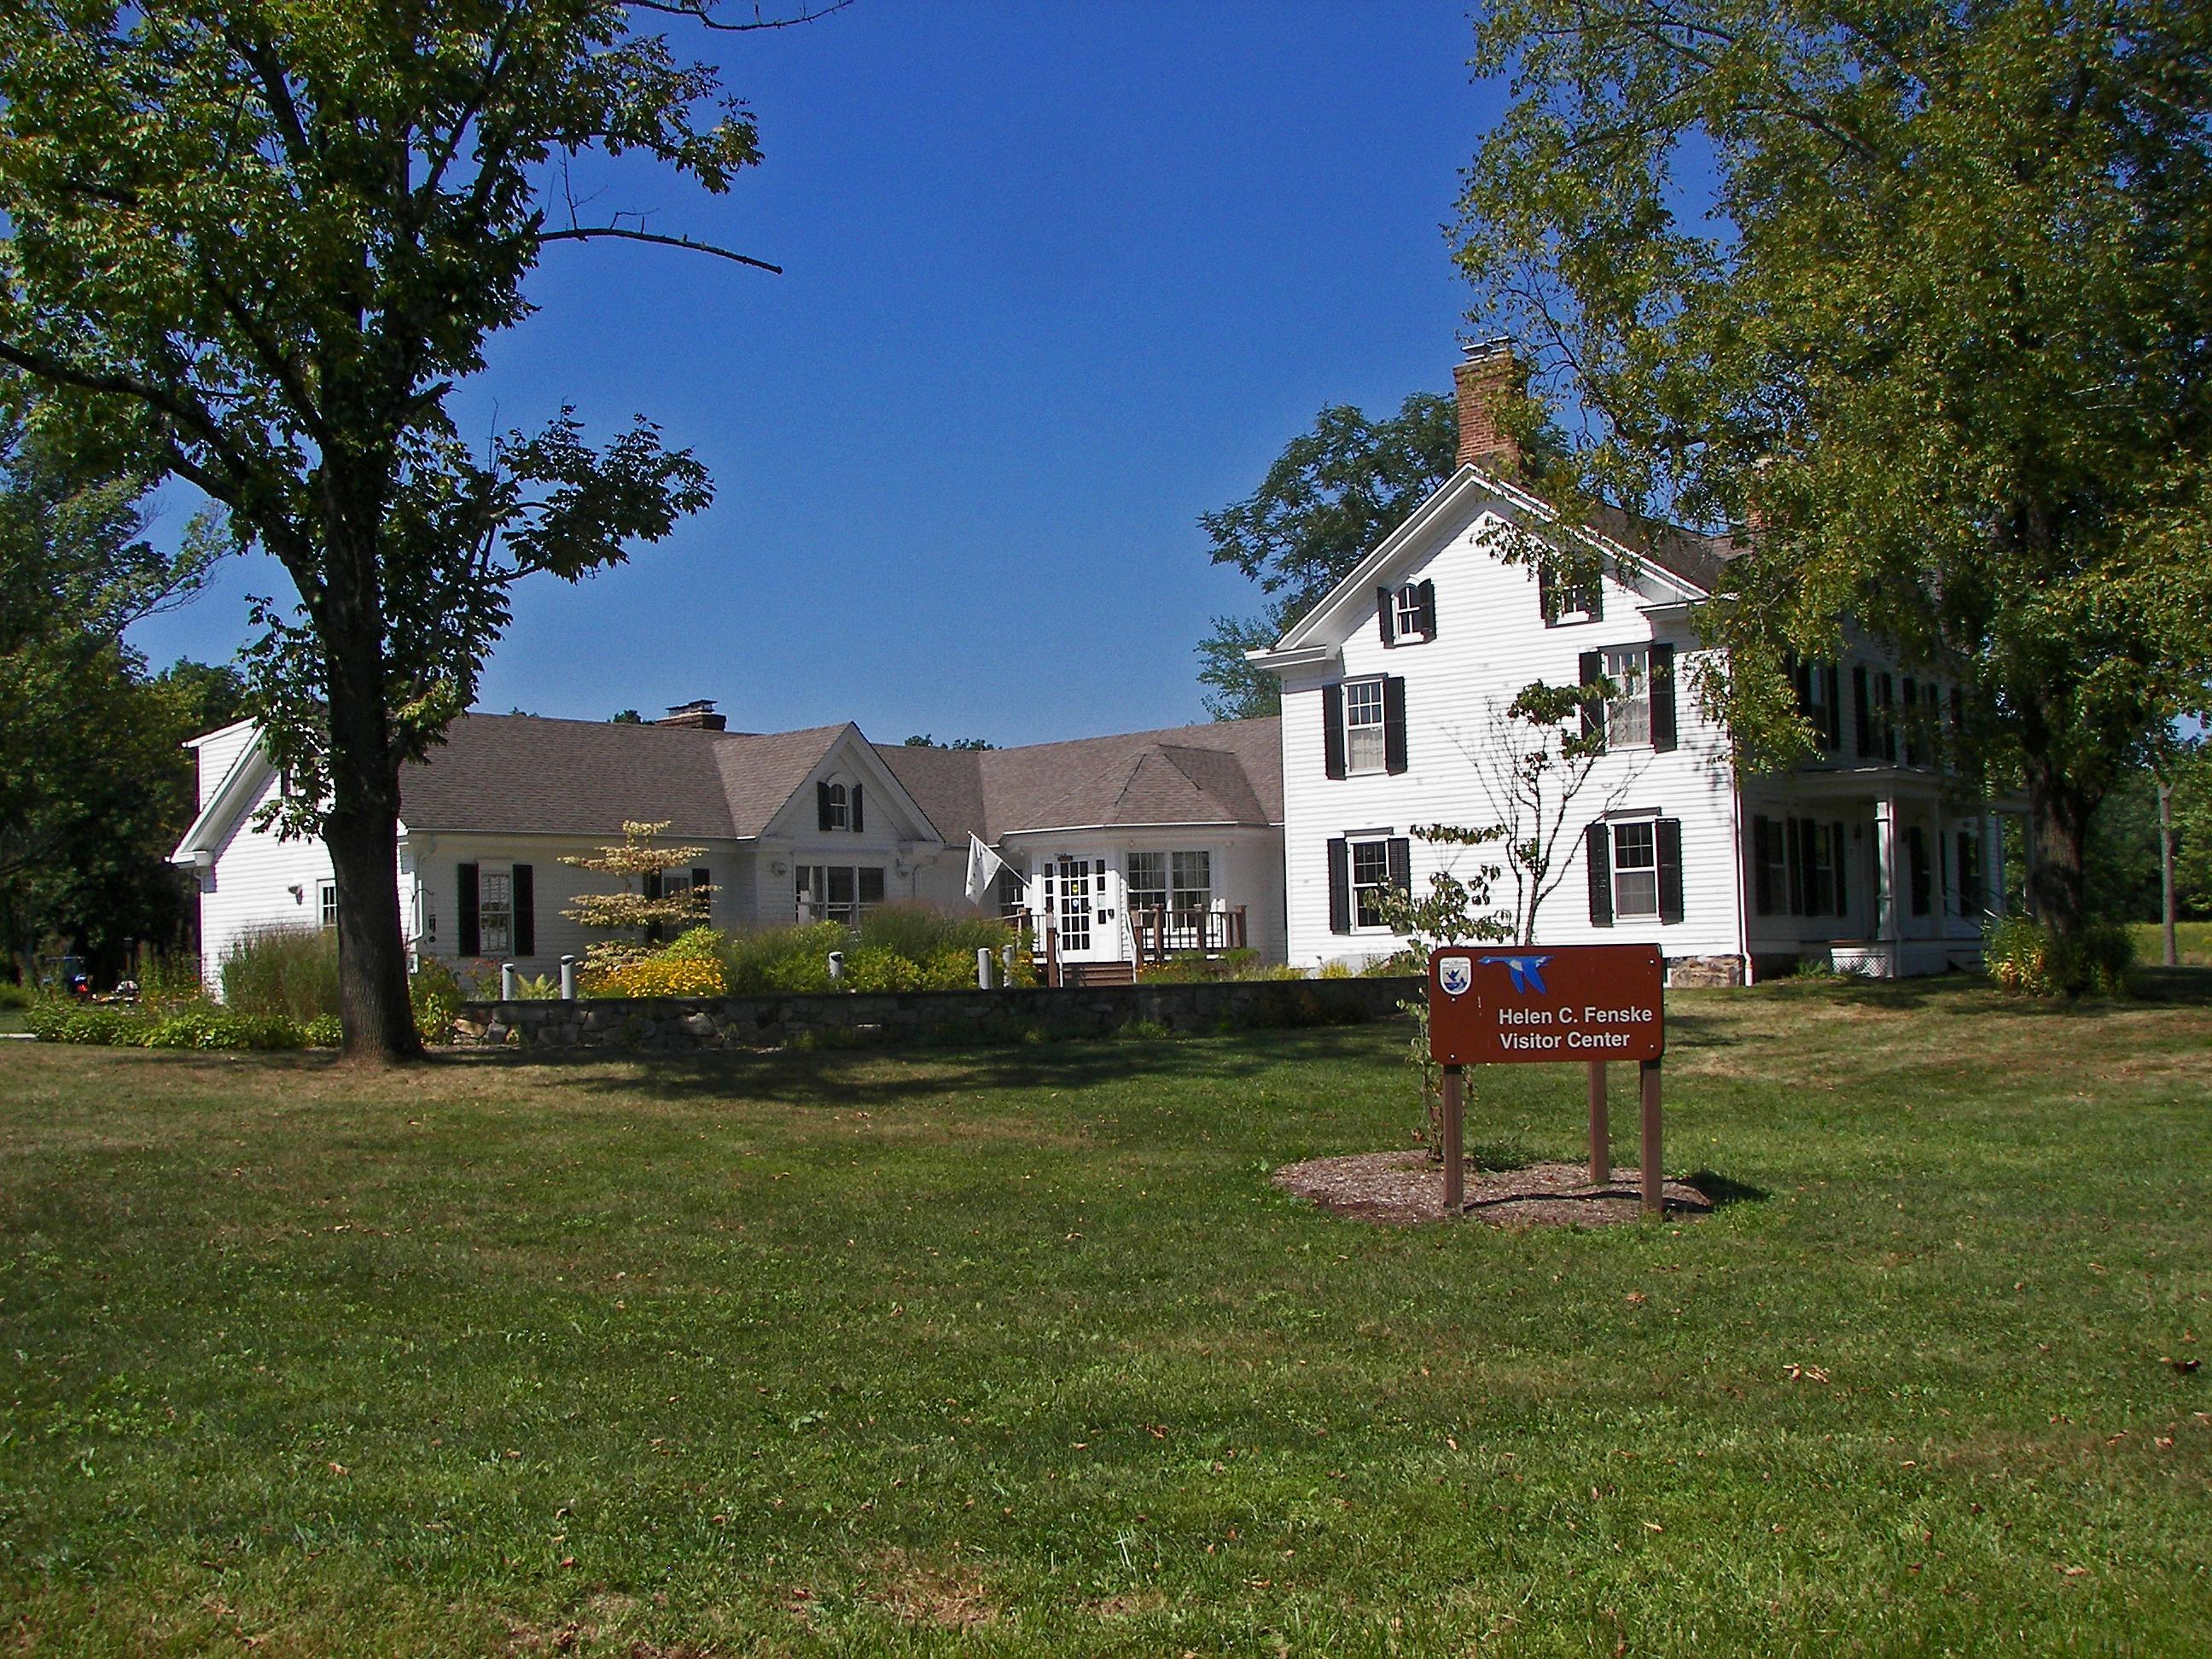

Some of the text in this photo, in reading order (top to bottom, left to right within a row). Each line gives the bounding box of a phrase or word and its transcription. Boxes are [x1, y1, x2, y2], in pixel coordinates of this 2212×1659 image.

[1499, 1006, 1653, 1024] Helen C. Fenske
[1499, 1031, 1630, 1050] Visitor Center
